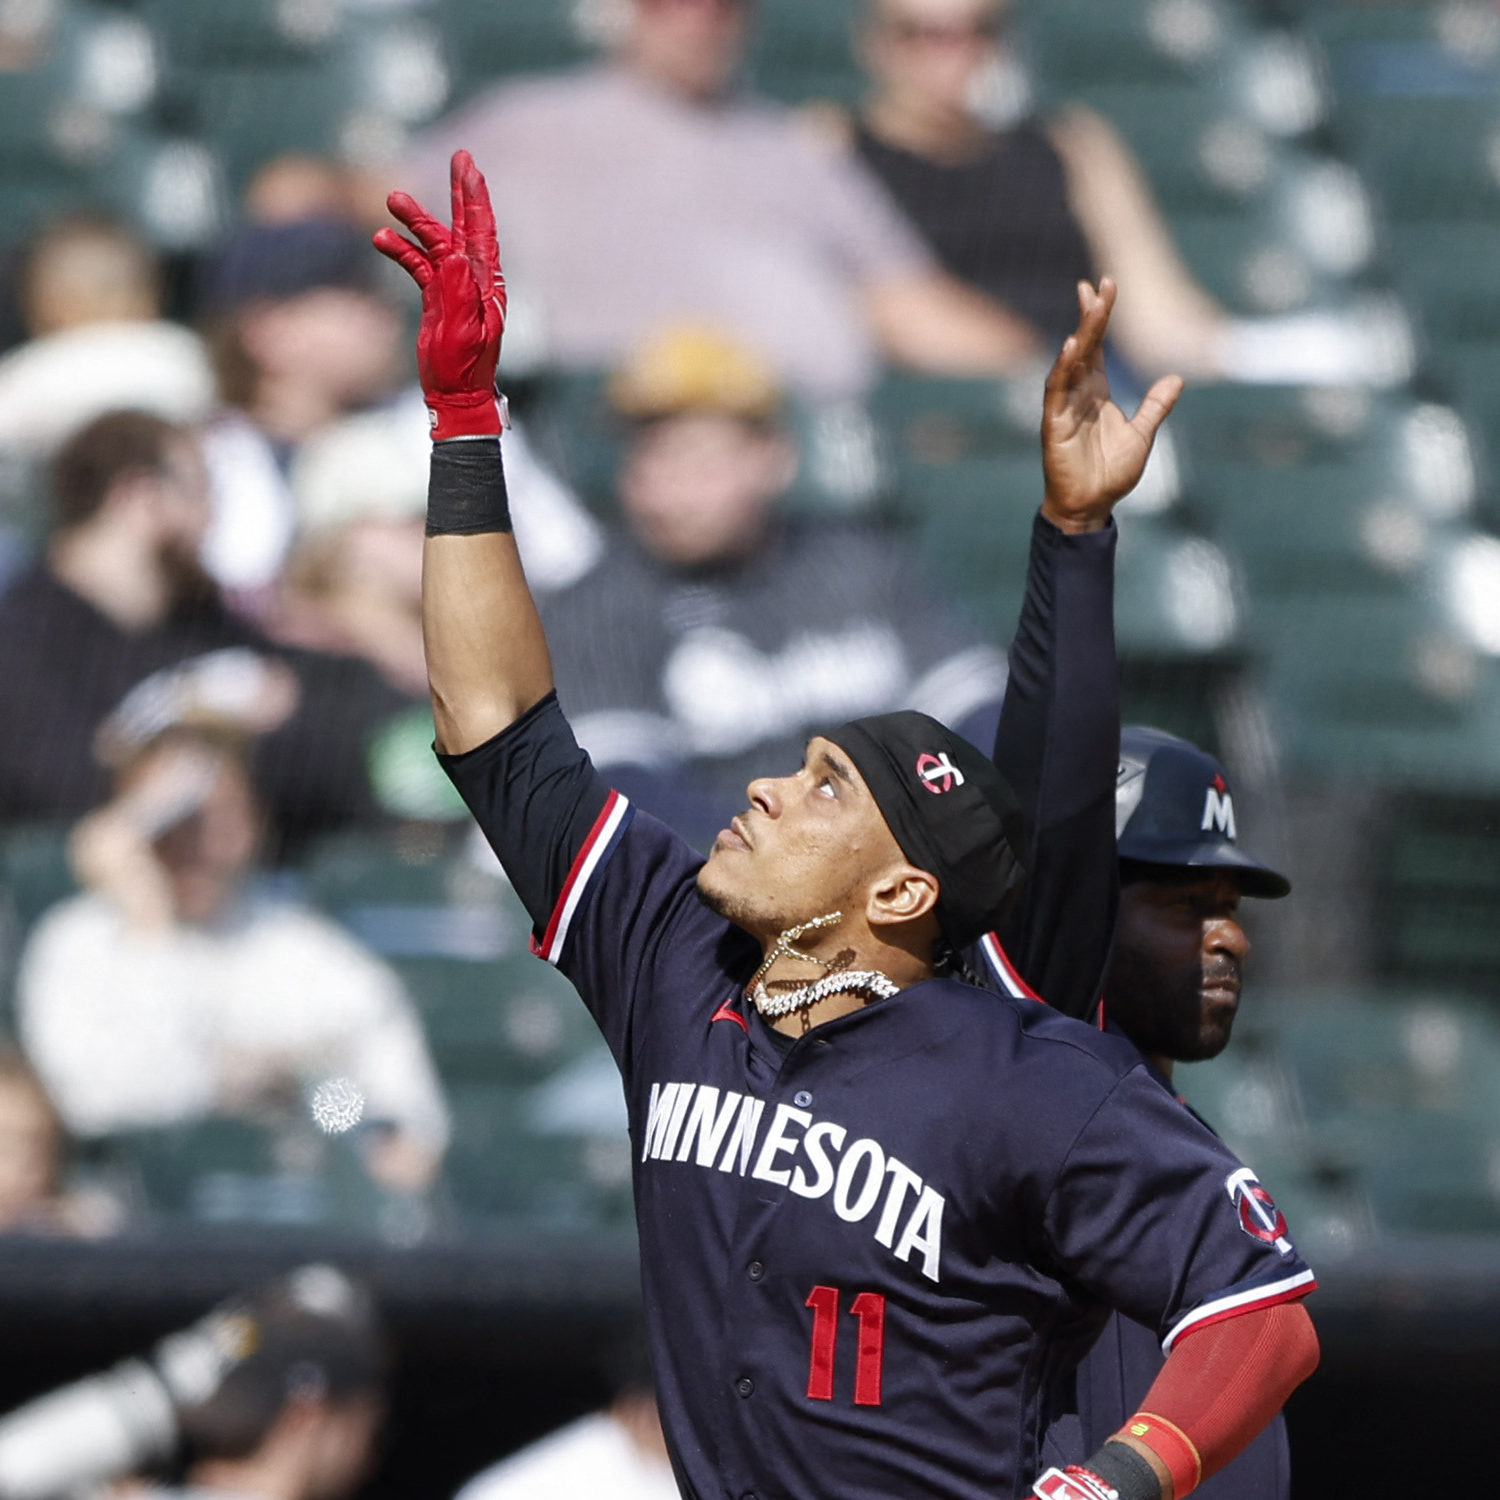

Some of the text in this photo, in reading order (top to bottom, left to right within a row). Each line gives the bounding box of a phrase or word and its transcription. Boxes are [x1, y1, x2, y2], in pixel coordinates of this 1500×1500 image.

[1201, 787, 1237, 841] M
[642, 1082, 946, 1283] MINNESOTA
[805, 1285, 886, 1406] 11
